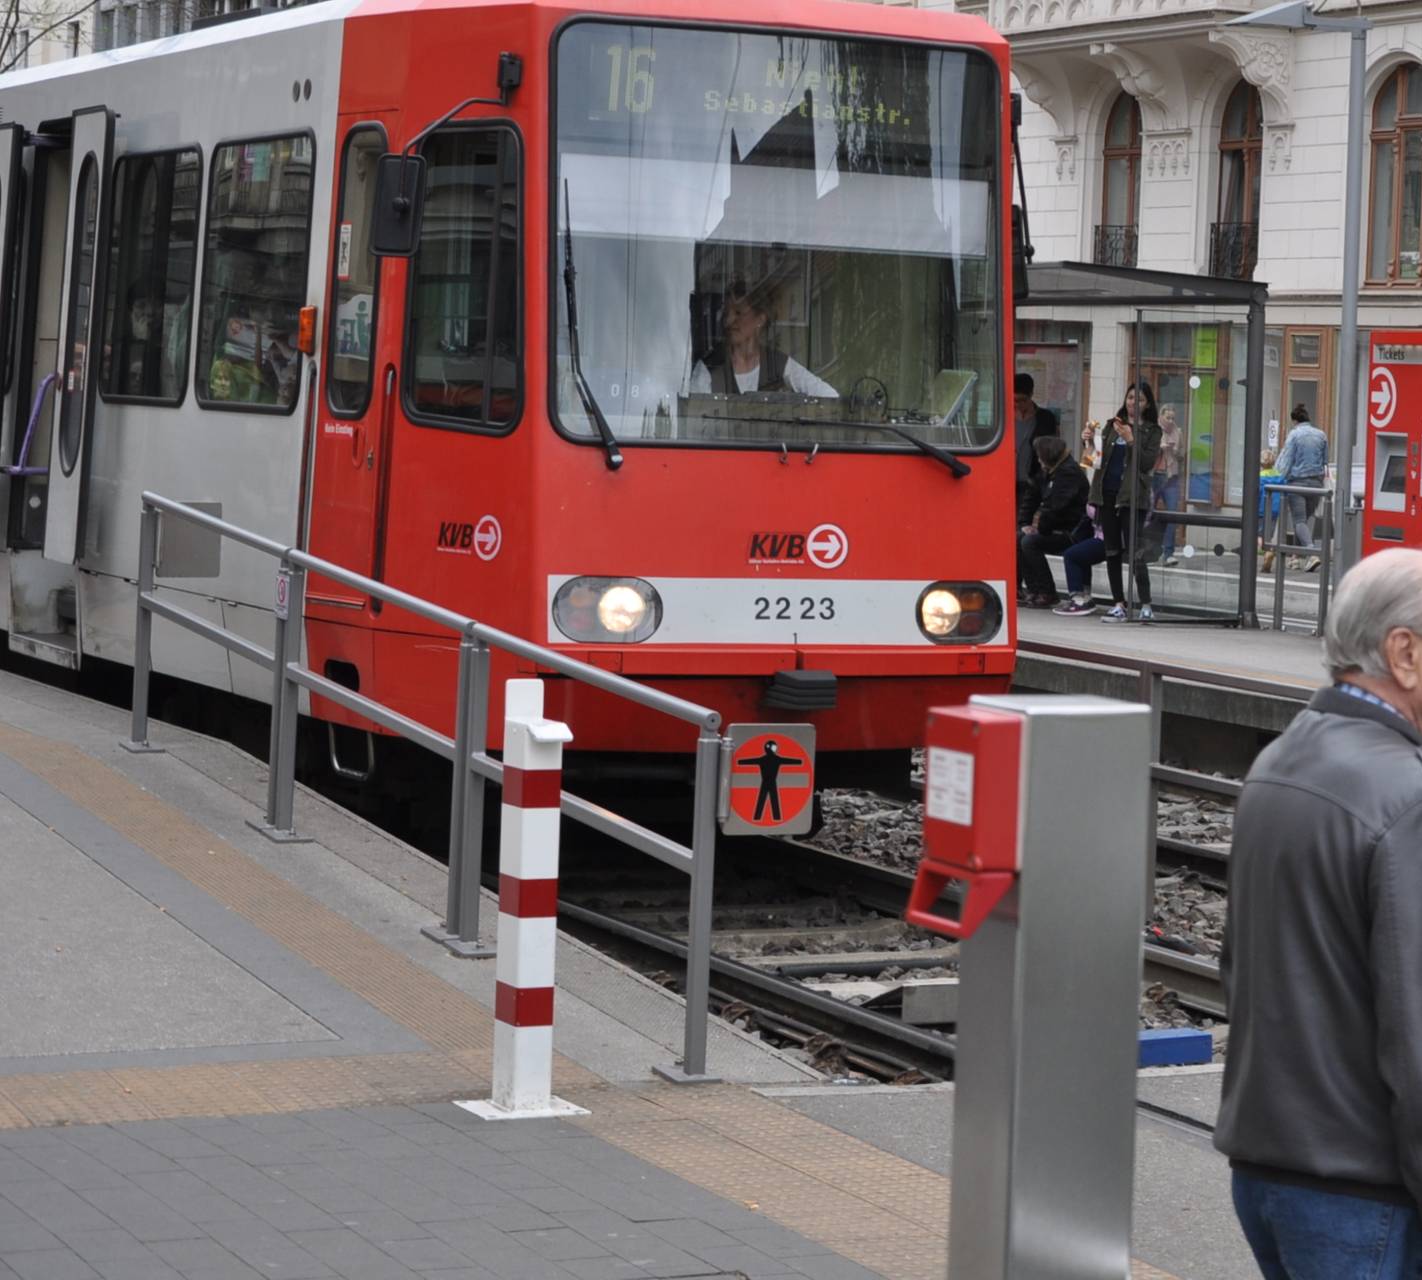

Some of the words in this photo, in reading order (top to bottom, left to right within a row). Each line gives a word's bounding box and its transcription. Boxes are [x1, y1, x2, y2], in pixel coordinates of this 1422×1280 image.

[608, 47, 656, 113] 16
[766, 59, 857, 94] Niehl
[704, 90, 911, 126] Sebastianstr.
[1378, 347, 1405, 361] Tickets
[438, 521, 474, 548] KVB
[749, 533, 805, 559] KVB
